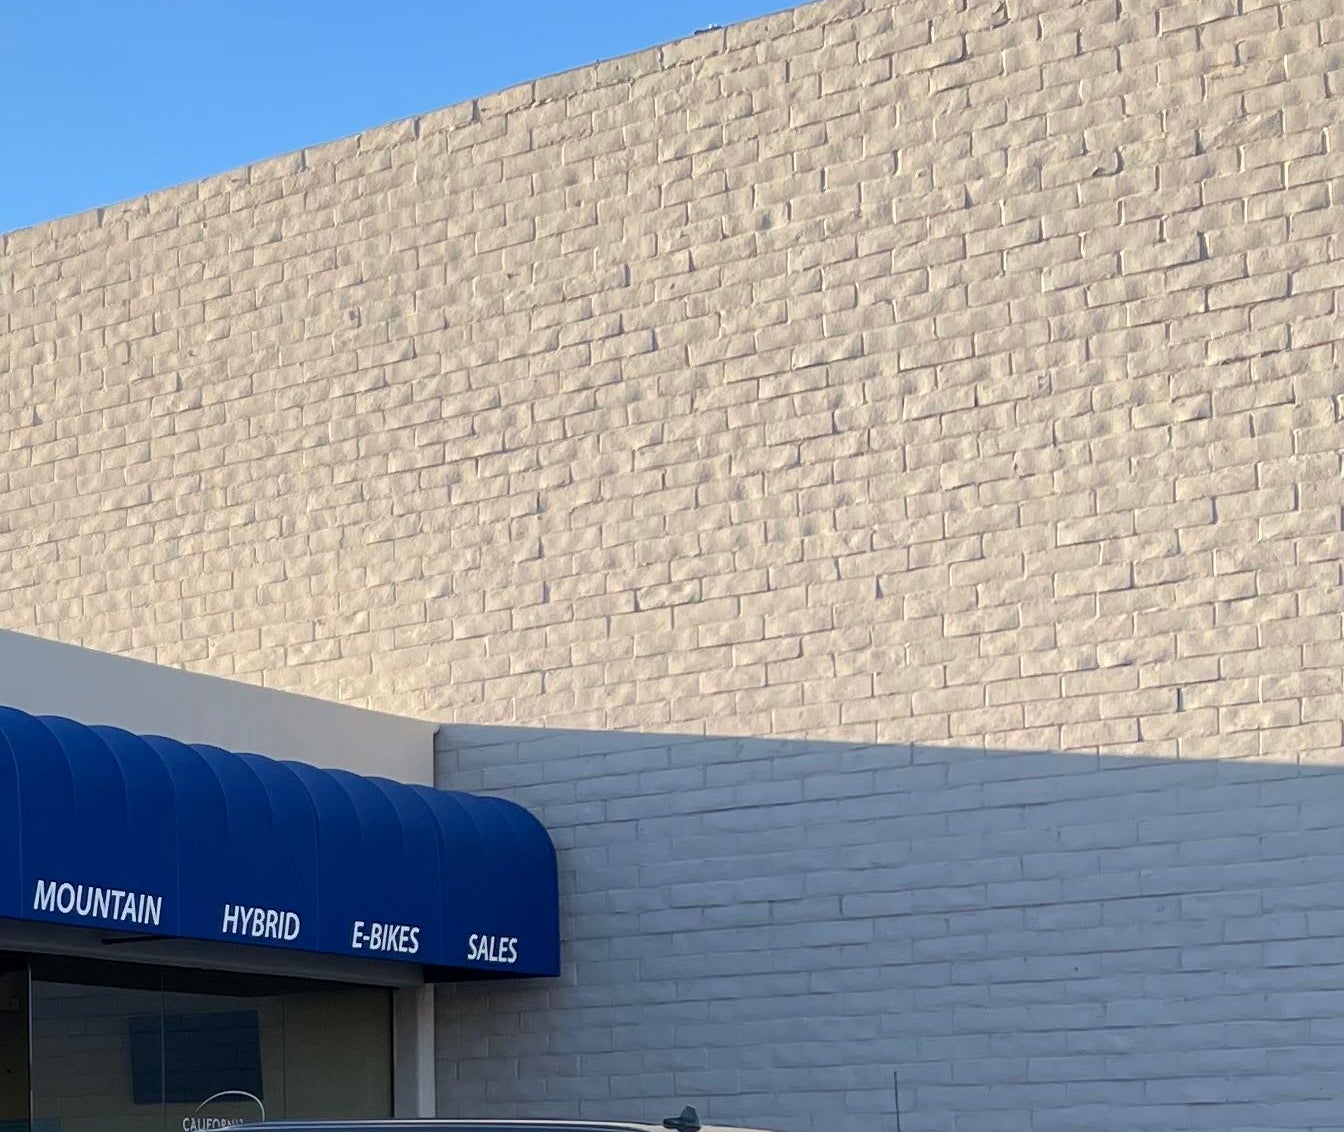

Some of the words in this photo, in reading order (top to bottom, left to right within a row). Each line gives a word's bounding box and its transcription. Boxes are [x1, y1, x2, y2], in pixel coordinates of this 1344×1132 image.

[33, 879, 163, 926] MOUNTAIN
[222, 904, 300, 941] HYBRID
[351, 920, 420, 954] E-BIKES
[467, 933, 518, 964] SALES
